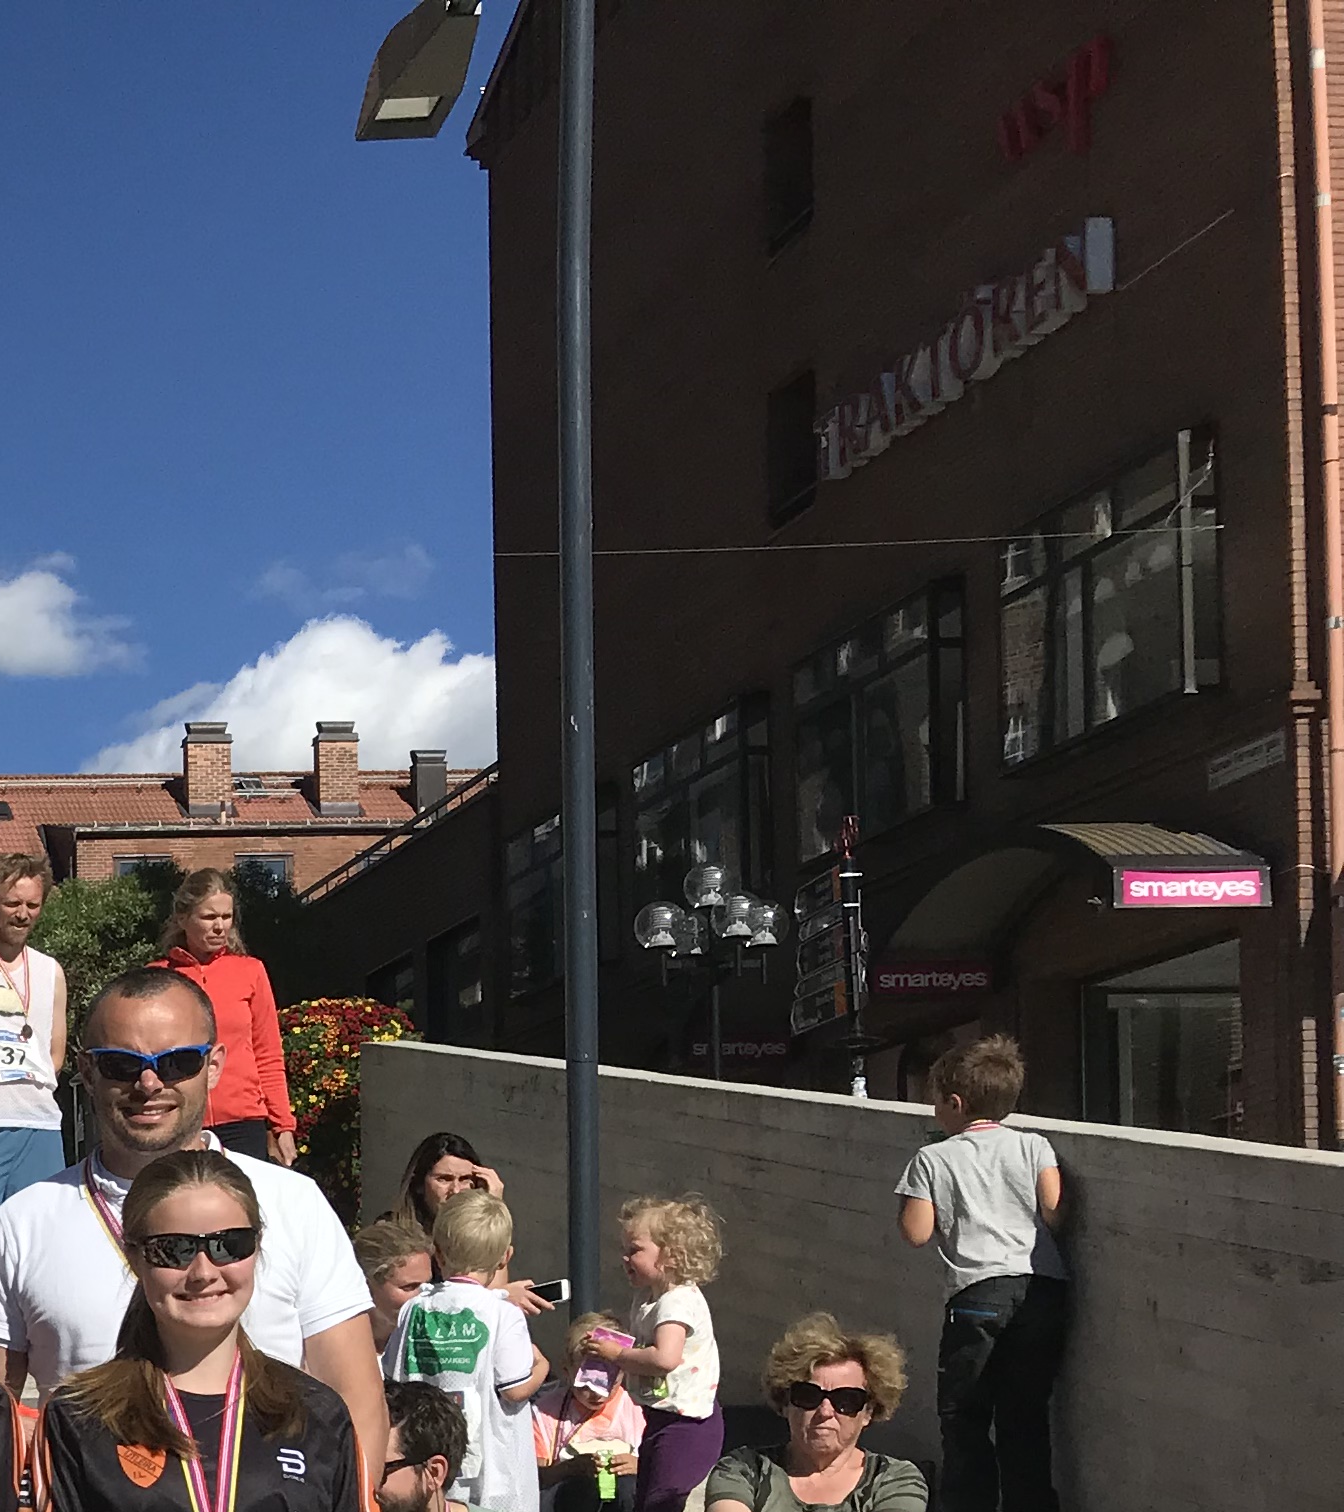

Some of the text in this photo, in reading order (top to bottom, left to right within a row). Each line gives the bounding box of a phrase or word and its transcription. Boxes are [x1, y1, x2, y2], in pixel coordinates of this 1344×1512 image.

[1129, 877, 1256, 900] smarteyes
[879, 969, 988, 991] smarteyes
[1, 1046, 26, 1065] 37
